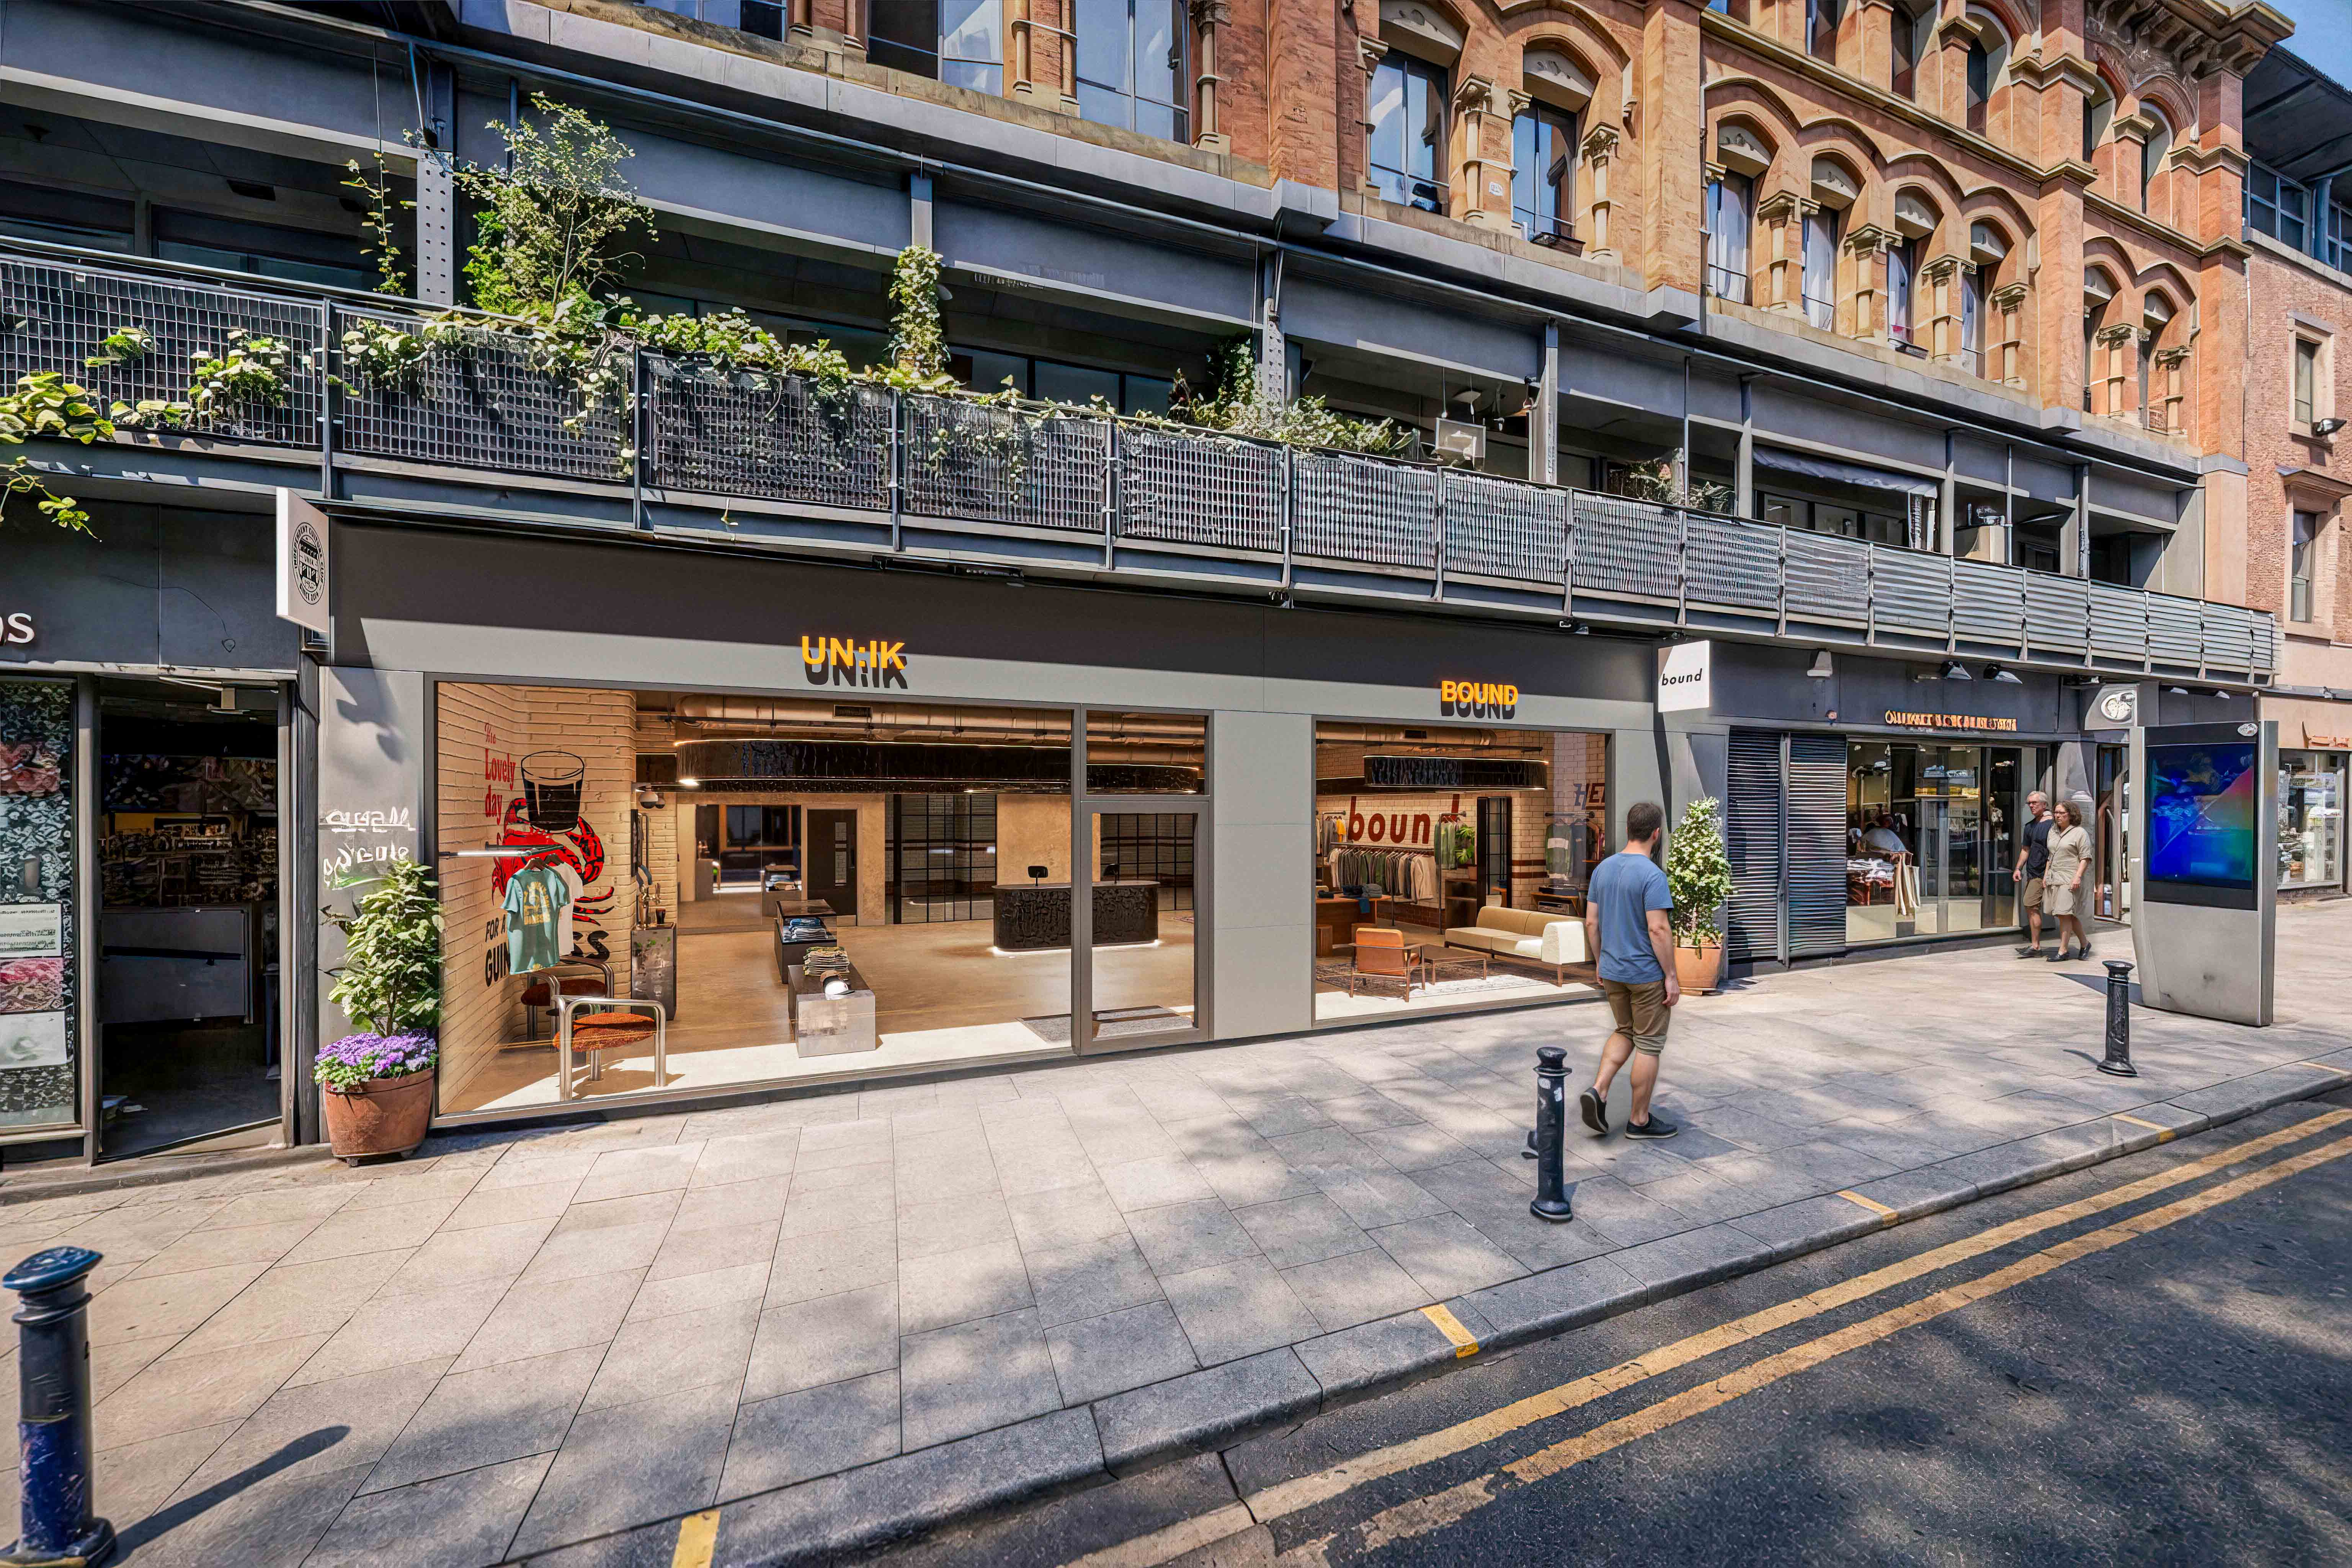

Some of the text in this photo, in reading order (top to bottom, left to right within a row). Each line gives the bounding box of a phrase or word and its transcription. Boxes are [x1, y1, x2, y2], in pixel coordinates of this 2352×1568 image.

[1661, 668, 1703, 686] bound
[1441, 680, 1519, 705] BOUND
[485, 748, 516, 791] Lovely
[485, 784, 503, 826] day
[1573, 783, 1605, 810] HE
[485, 917, 499, 942] FOR
[501, 914, 506, 934] A
